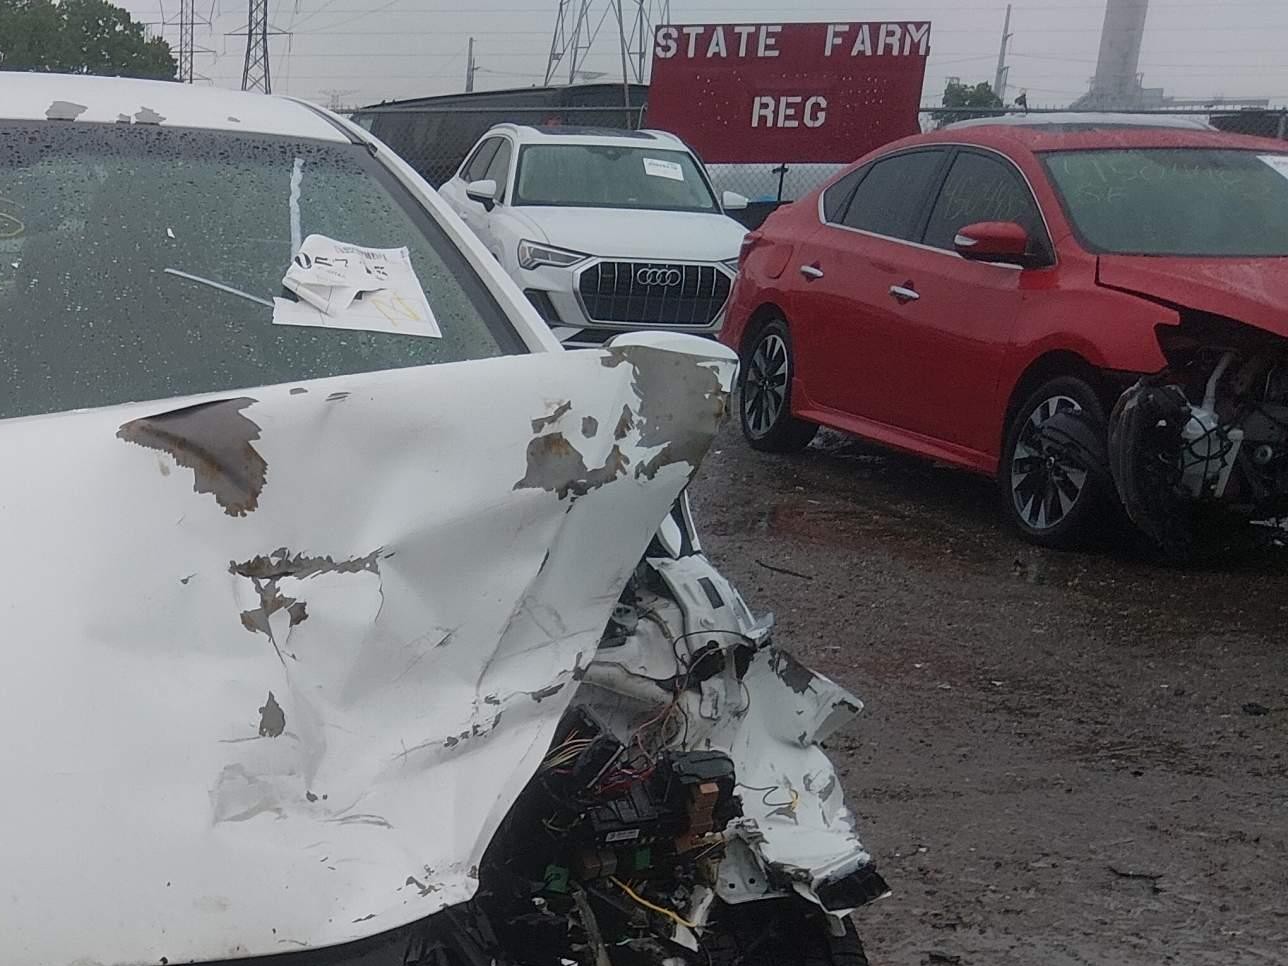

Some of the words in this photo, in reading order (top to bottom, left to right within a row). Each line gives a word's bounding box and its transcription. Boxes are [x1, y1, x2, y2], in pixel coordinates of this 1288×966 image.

[655, 25, 784, 59] STATE
[824, 23, 930, 57] FARM
[751, 96, 828, 128] REG
